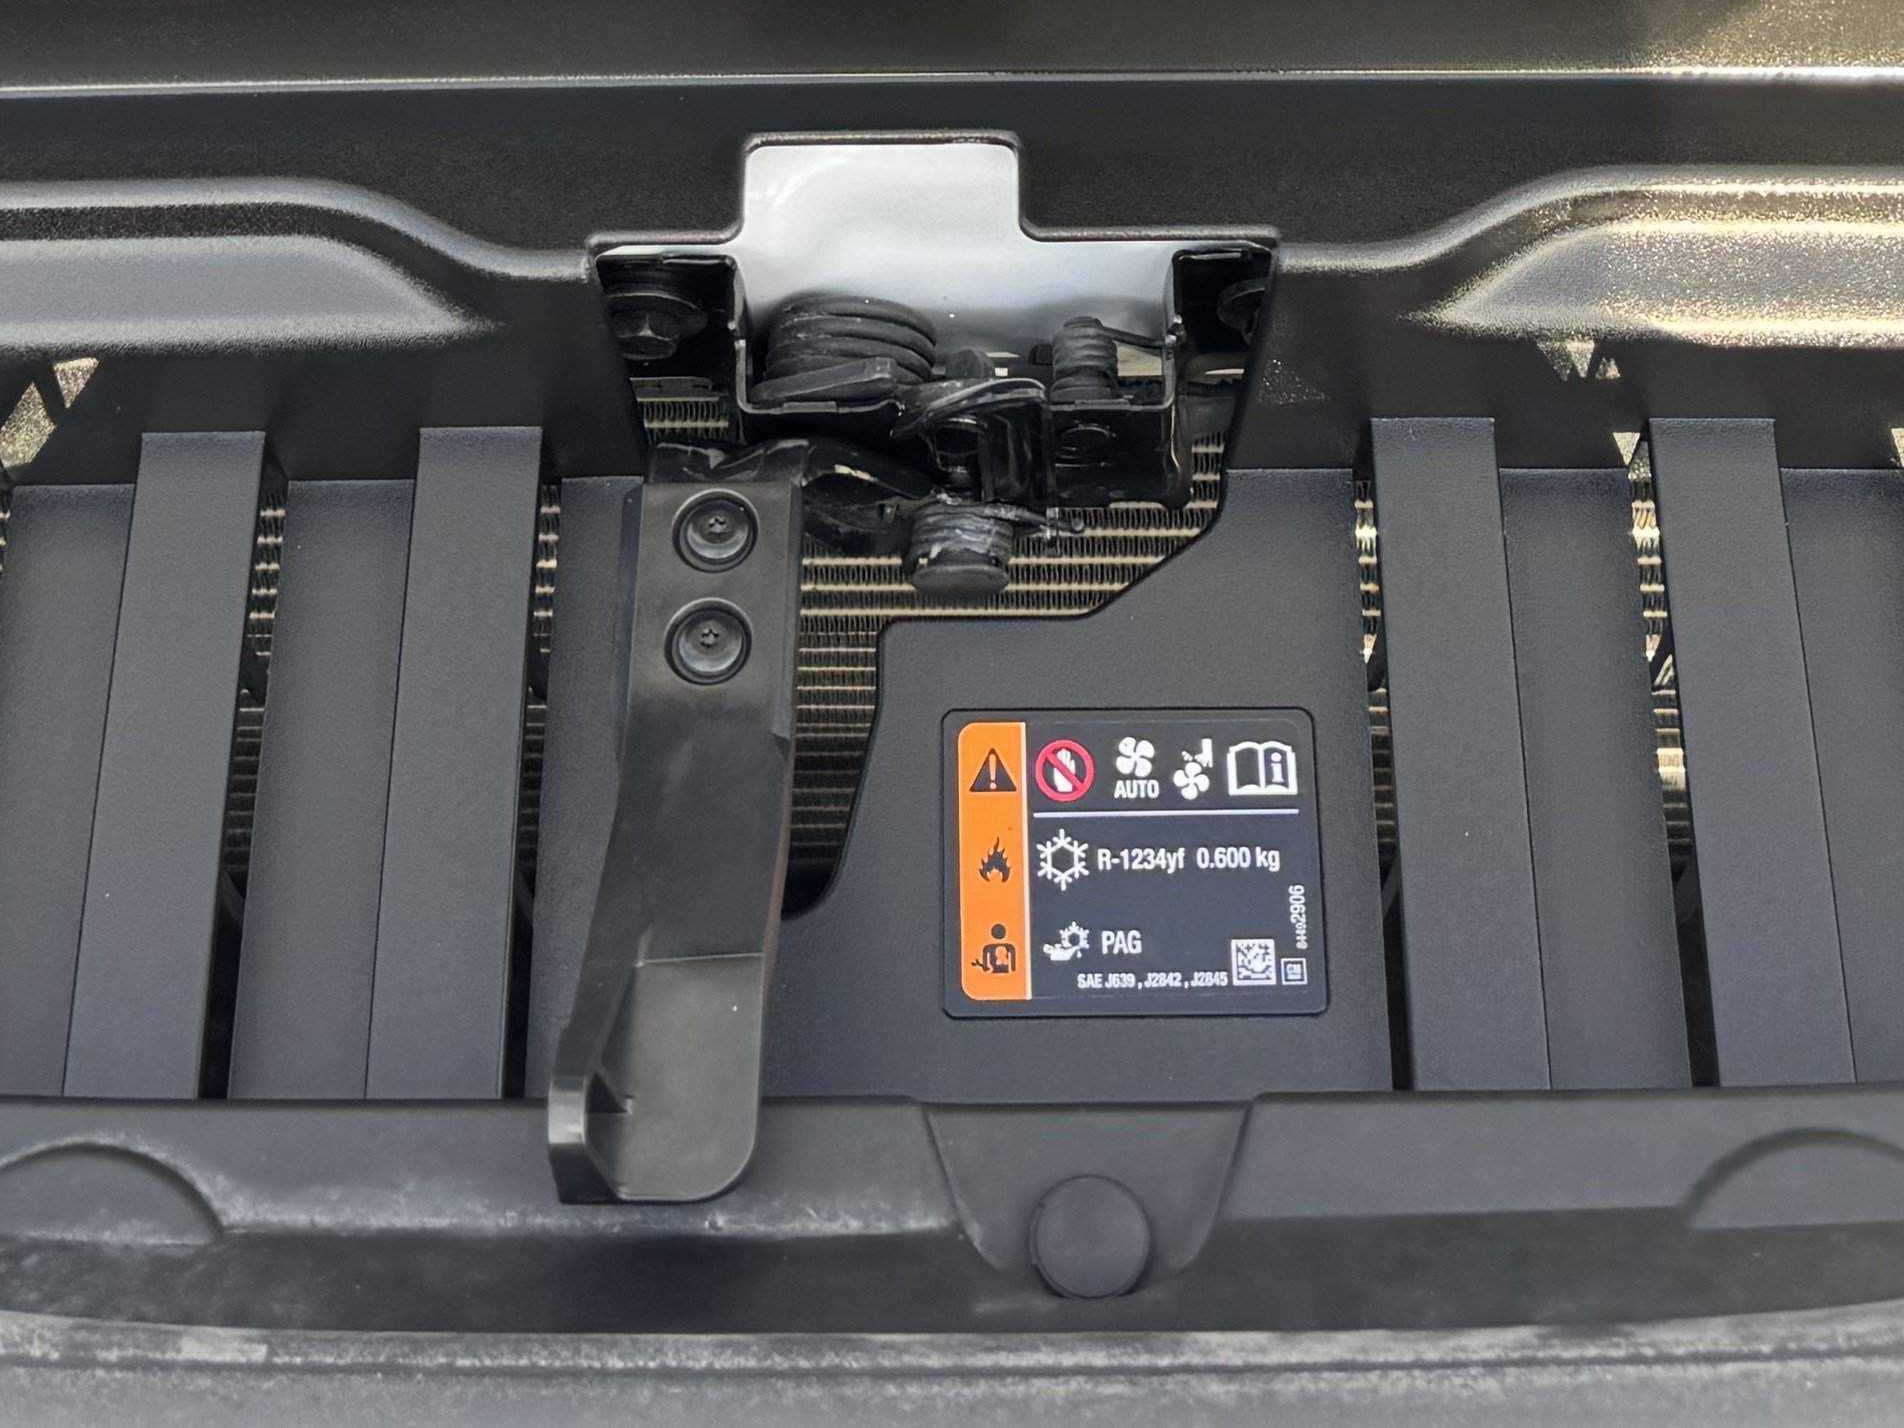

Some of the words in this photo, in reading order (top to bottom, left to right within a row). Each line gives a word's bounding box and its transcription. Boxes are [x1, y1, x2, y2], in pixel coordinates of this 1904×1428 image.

[1114, 779, 1160, 799] AUTO
[1097, 847, 1186, 874] R-1234yf
[1196, 846, 1251, 870] 0.600
[1255, 846, 1281, 872] kg
[1101, 930, 1142, 955] PAG
[1076, 972, 1103, 989] SAE
[1190, 970, 1229, 987] J2845
